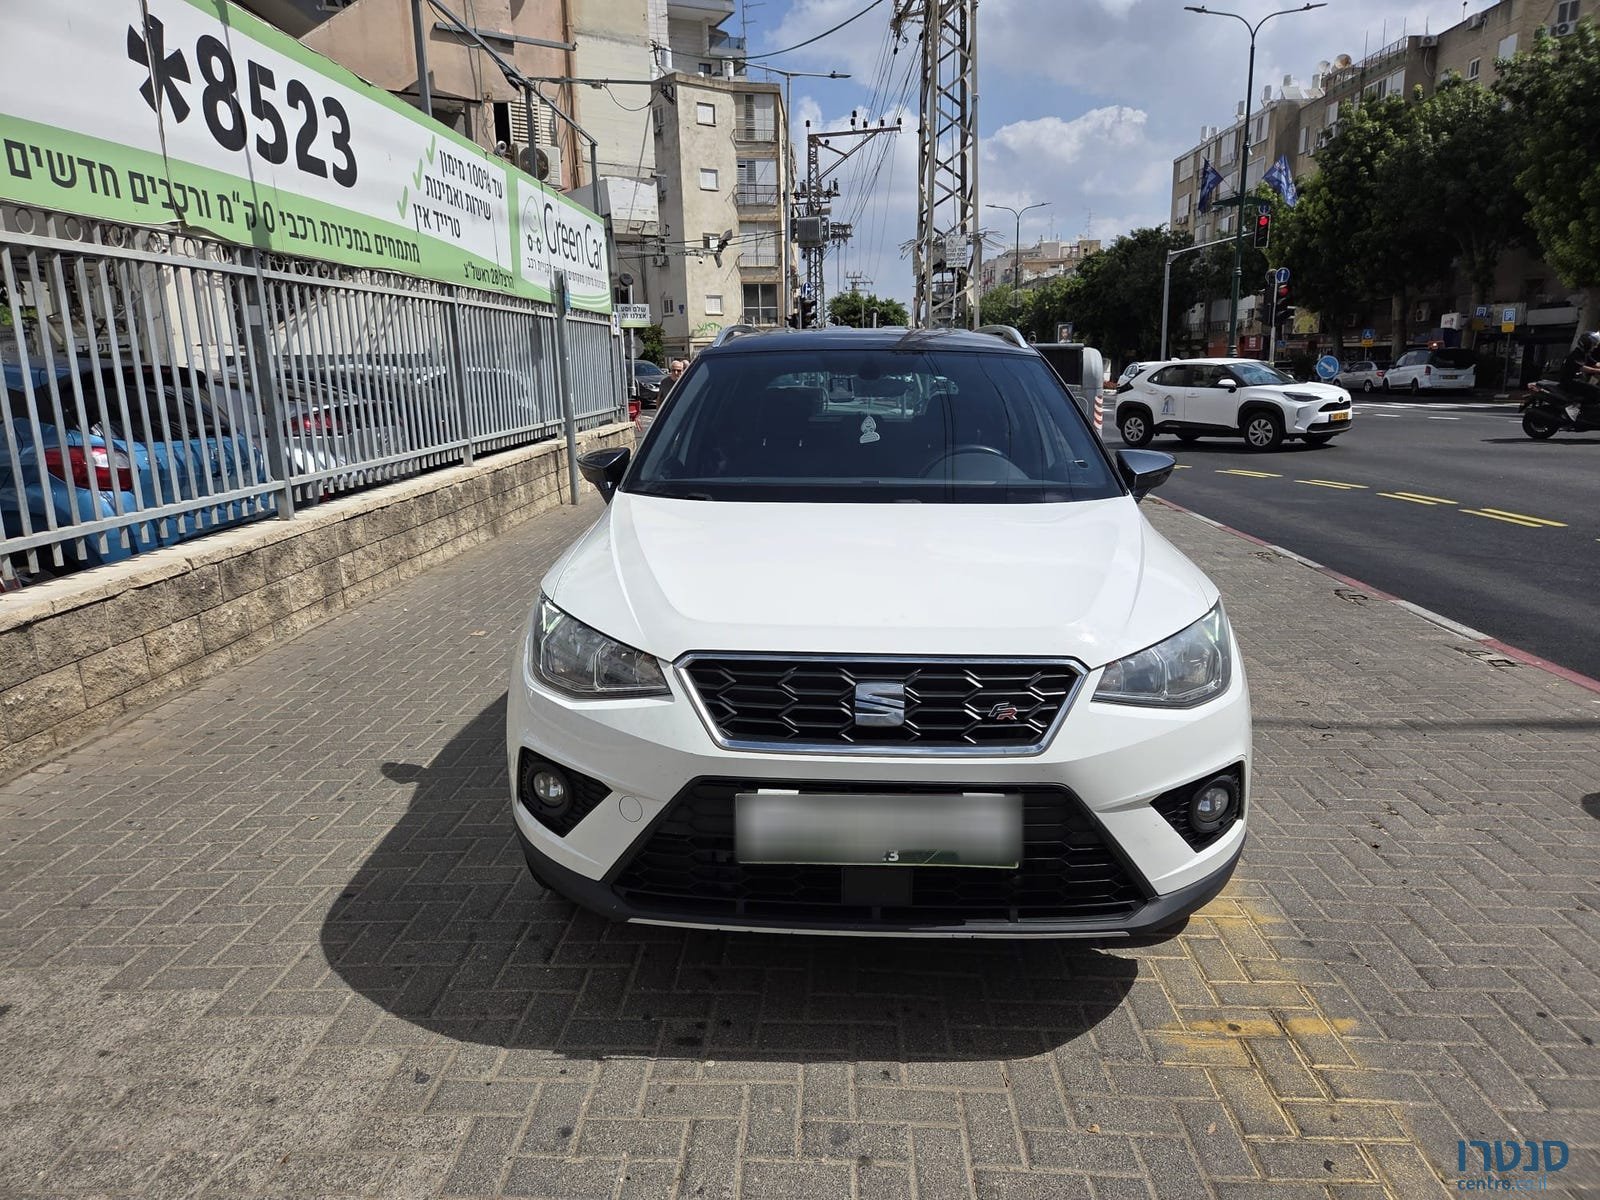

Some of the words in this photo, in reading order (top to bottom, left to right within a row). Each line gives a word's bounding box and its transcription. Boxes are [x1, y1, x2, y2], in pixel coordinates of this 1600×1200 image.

[4, 139, 121, 199] חדשים
[439, 150, 465, 181] מימון
[467, 162, 491, 193] 100%
[128, 169, 211, 219] ורכבים
[425, 175, 464, 210] ואמינות
[491, 178, 502, 199] עד
[262, 200, 275, 234] 0
[413, 203, 432, 232] אין
[465, 193, 491, 220] שירות
[279, 210, 318, 242] רכבי
[320, 220, 373, 254] במכירת
[433, 210, 461, 238] טרייד
[544, 202, 584, 265] Green
[584, 223, 603, 271] Car
[374, 233, 420, 264] מתמחים
[632, 305, 647, 313] שלם
